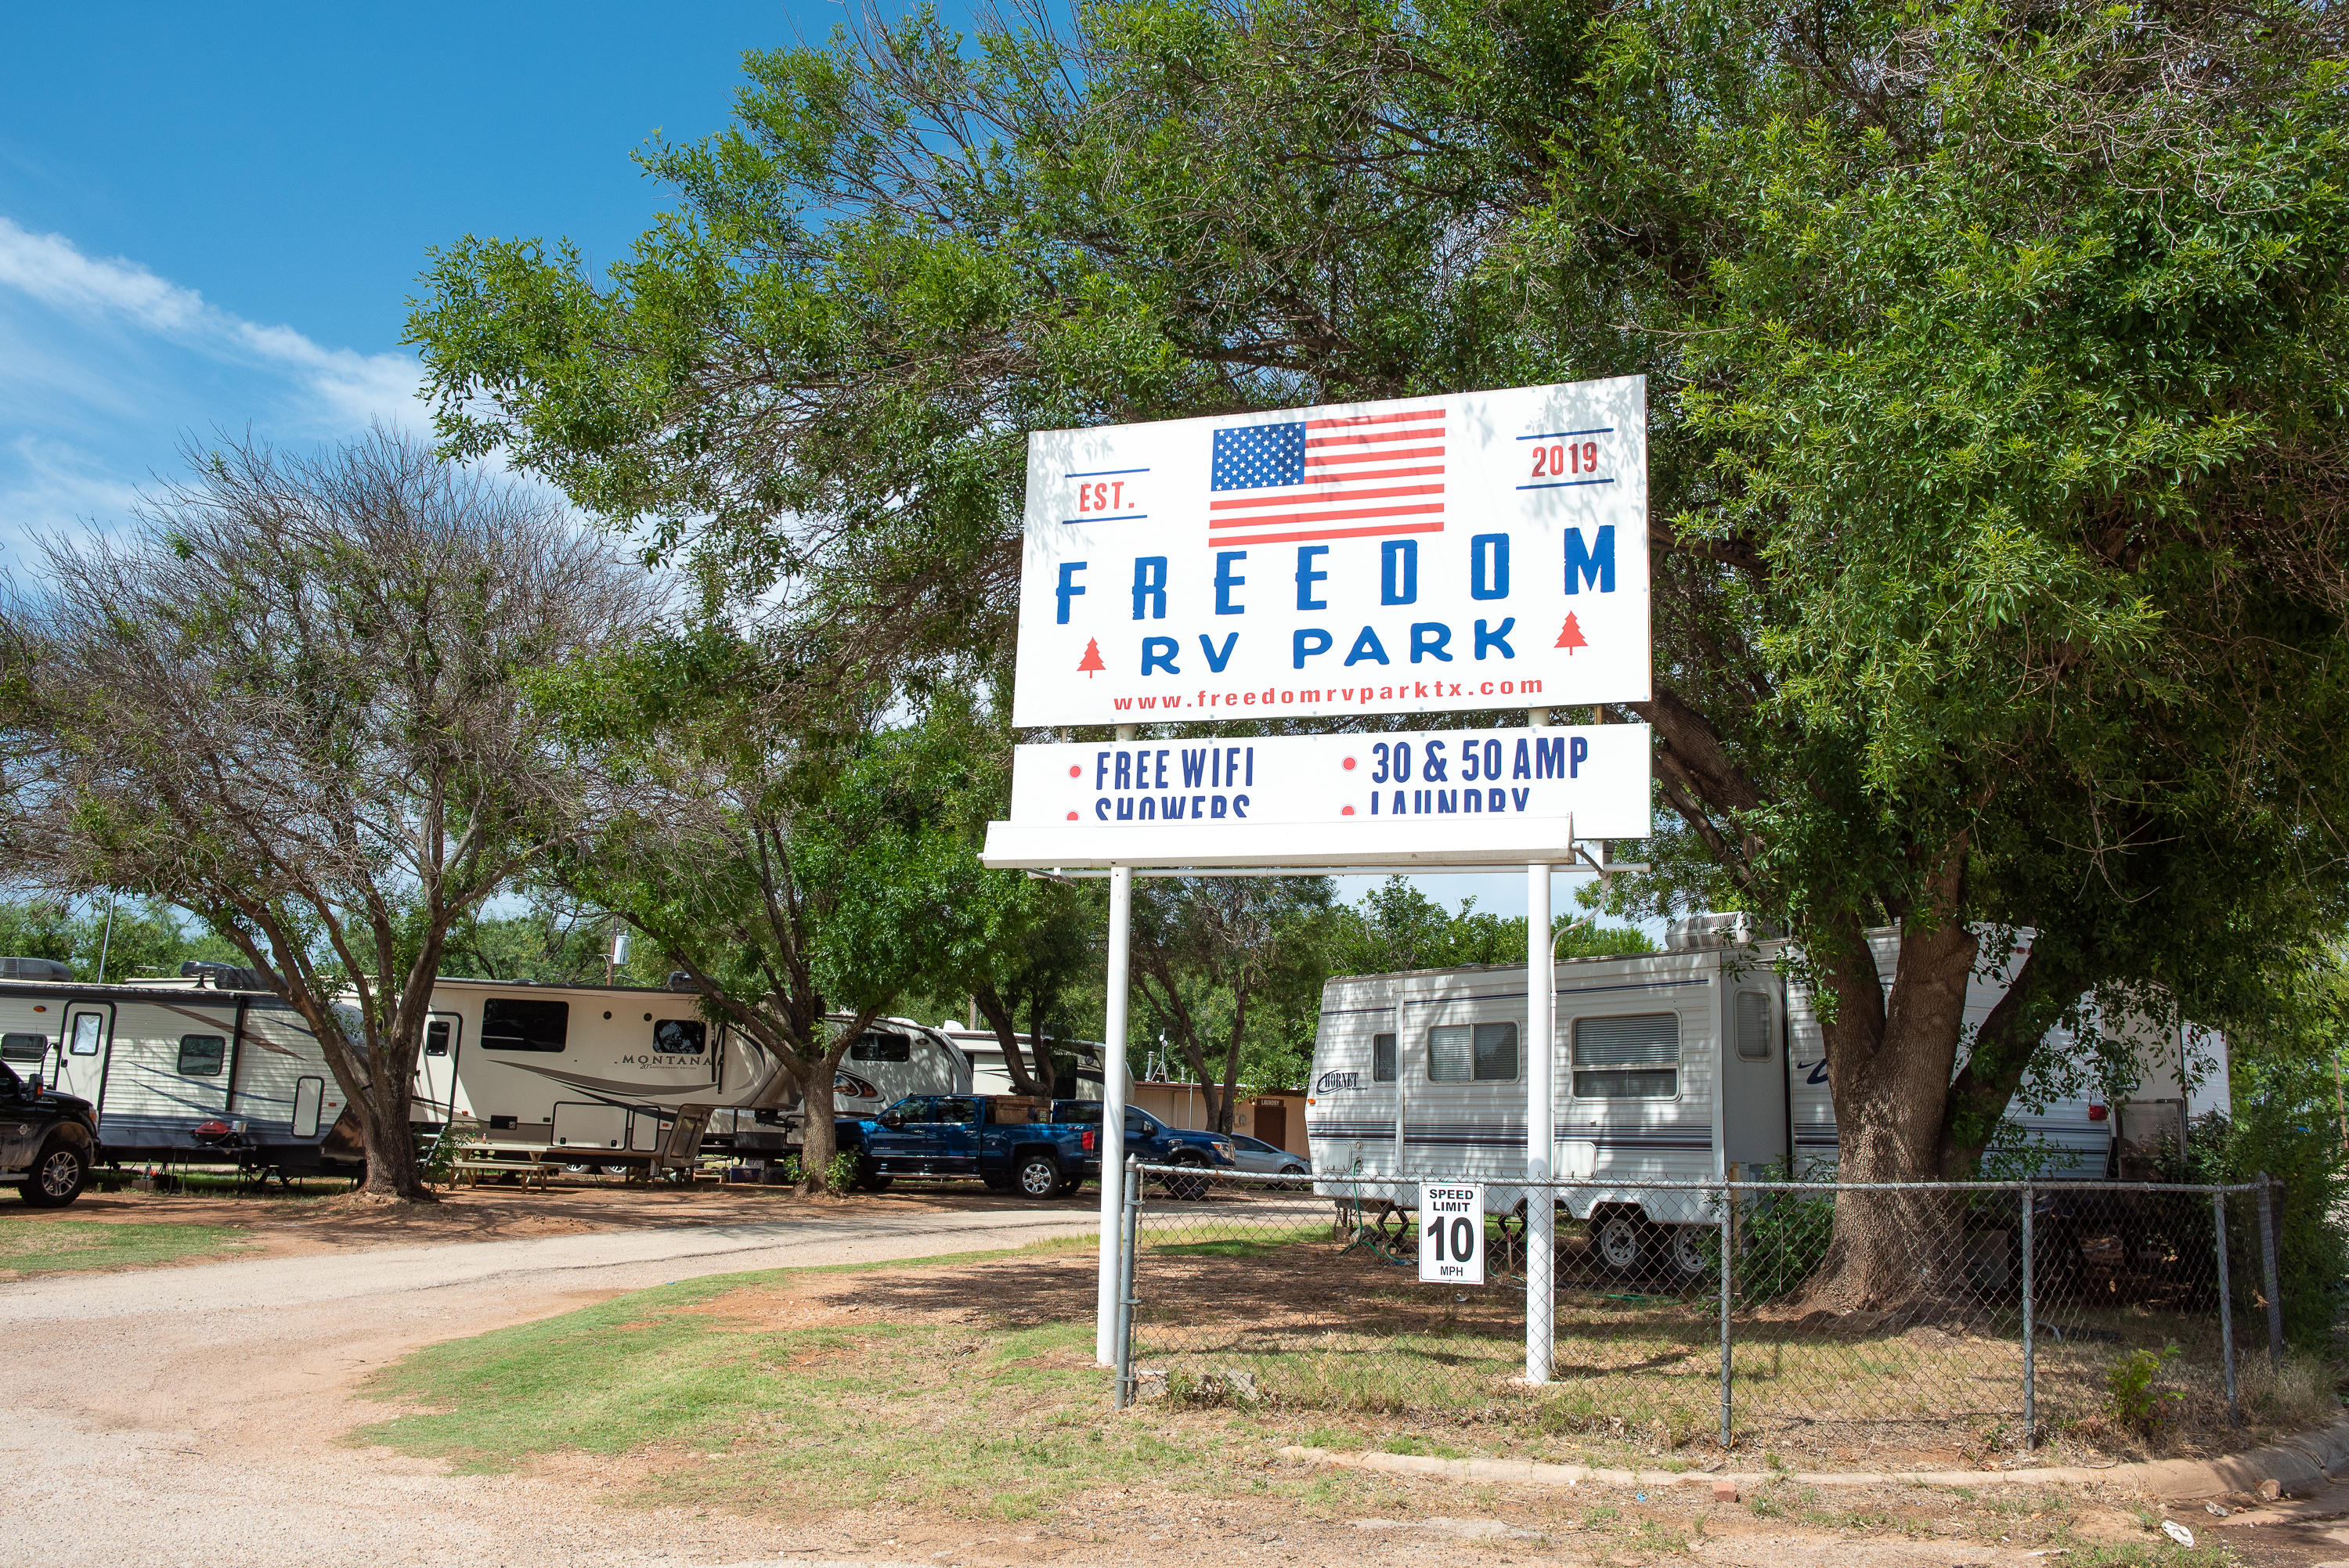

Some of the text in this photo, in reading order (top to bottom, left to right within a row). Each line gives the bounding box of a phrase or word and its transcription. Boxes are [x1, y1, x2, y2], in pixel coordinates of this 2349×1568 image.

[1532, 442, 1597, 477] 2019
[1080, 481, 1135, 512] EST.
[1056, 525, 1615, 625] FREEDOM
[1141, 617, 1517, 676] RV PARK
[1113, 676, 1544, 711] www.freedomrvparktx.com
[1096, 747, 1254, 791] FREE WIFI
[1372, 736, 1588, 784] 30 & 50 AMP
[622, 1054, 712, 1065] MONTANA
[1324, 1072, 1359, 1087] HORNET
[1429, 1188, 1474, 1200] SPEED
[1433, 1201, 1470, 1213] LIMIT
[1427, 1216, 1474, 1263] 10
[1440, 1266, 1463, 1277] MPH
